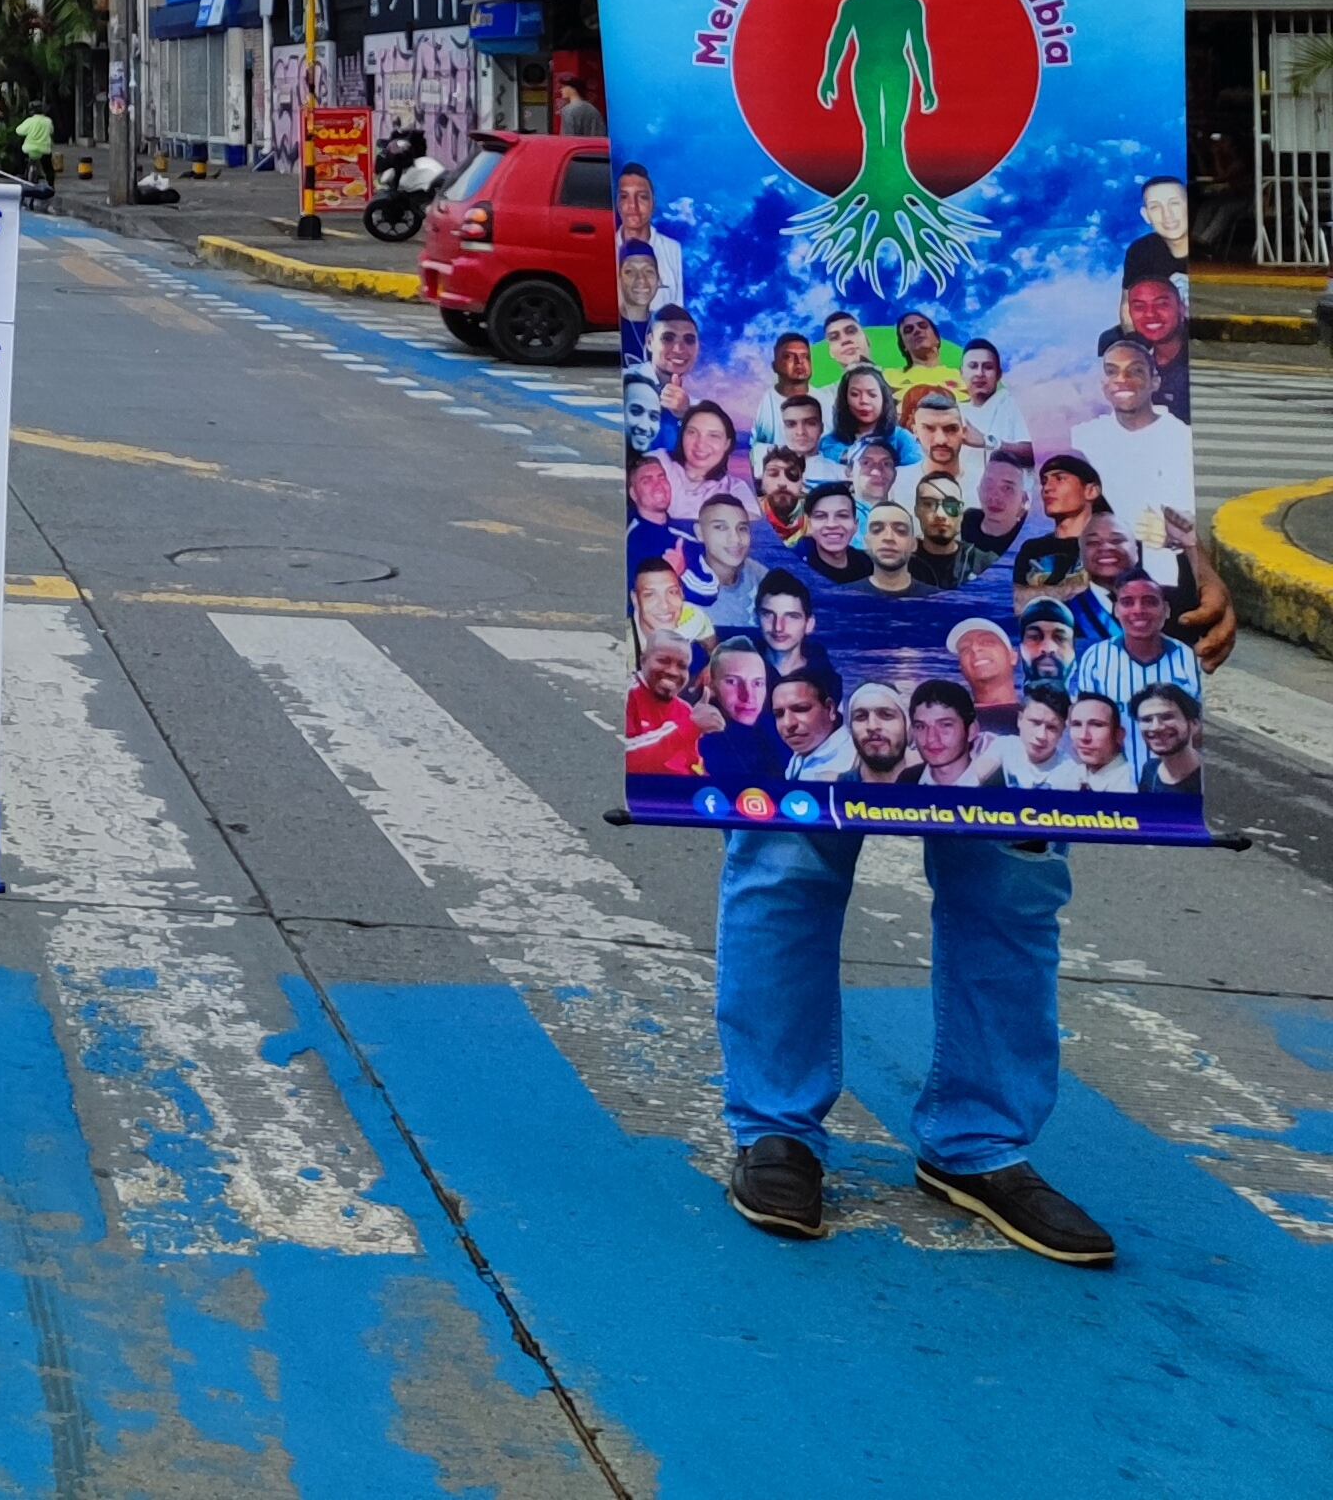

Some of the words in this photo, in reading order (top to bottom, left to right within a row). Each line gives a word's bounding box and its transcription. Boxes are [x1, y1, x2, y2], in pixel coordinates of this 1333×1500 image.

[845, 802, 955, 823] Memoria
[957, 806, 1015, 825] Viva
[1020, 808, 1139, 830] Colombia
